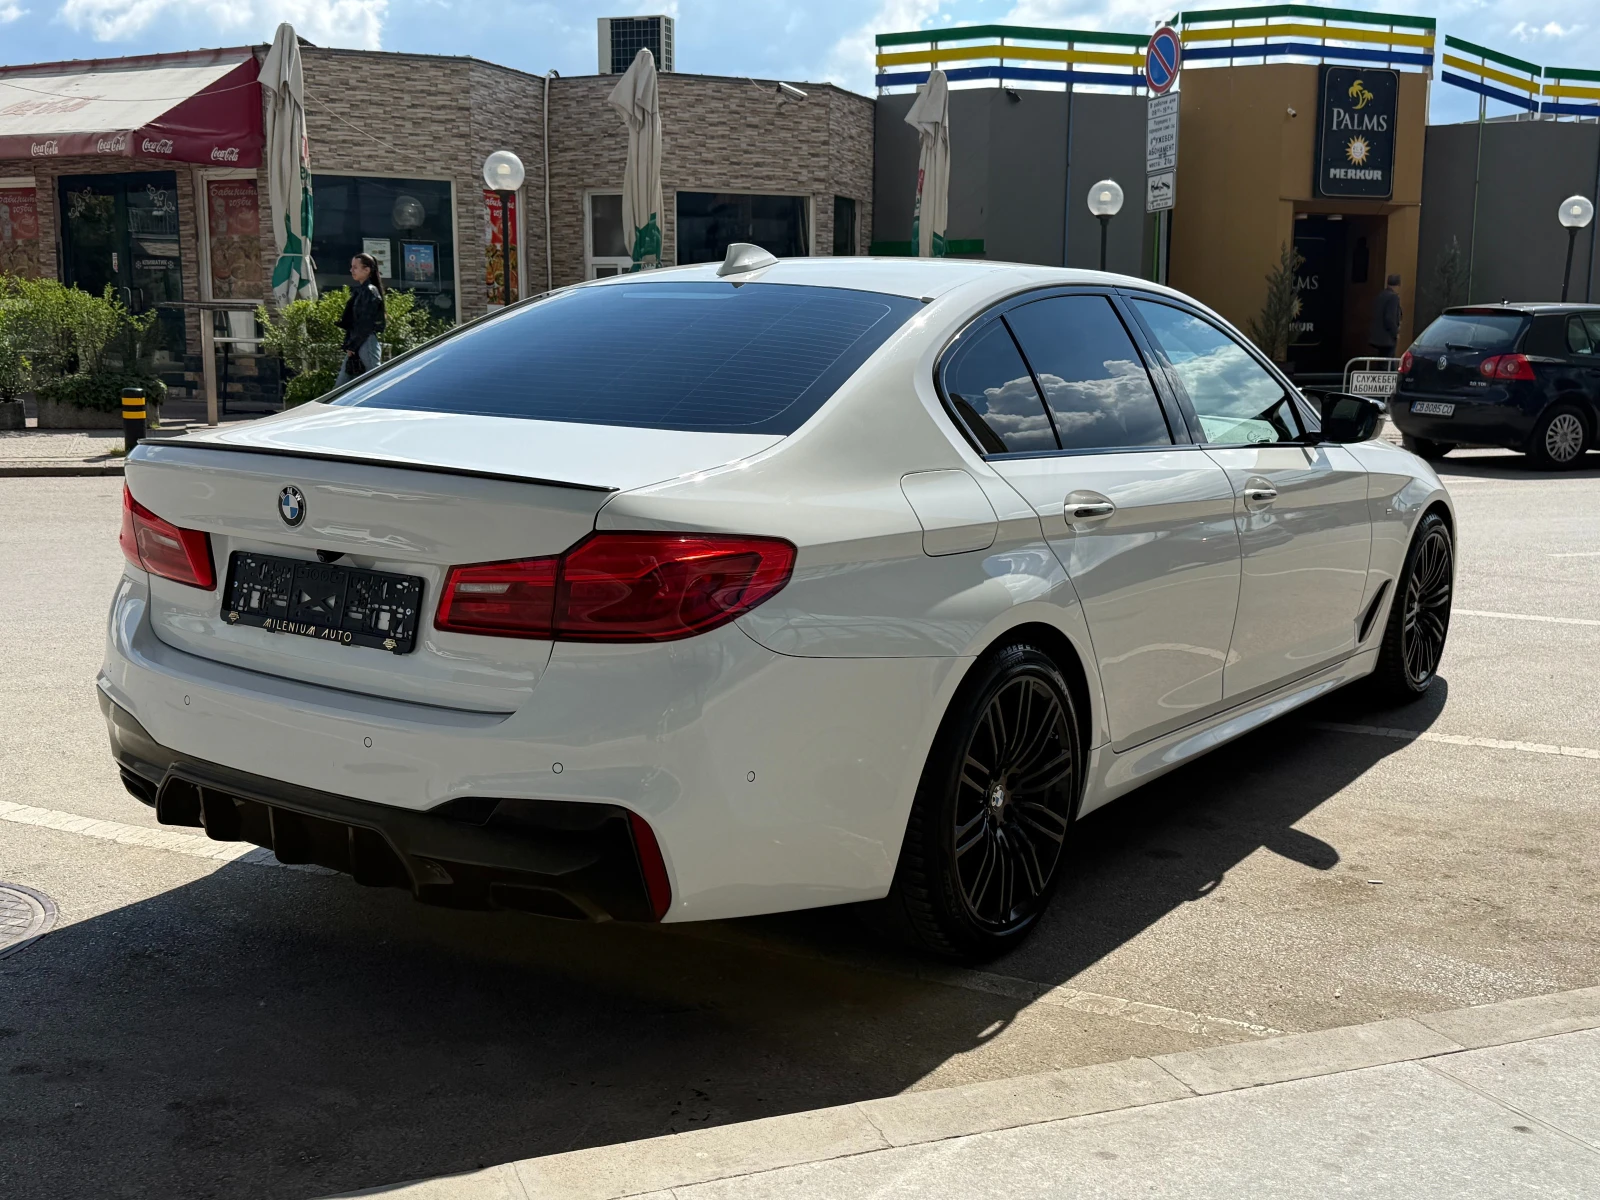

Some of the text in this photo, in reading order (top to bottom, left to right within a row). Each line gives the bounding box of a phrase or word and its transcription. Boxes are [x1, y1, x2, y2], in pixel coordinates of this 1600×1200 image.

[1331, 107, 1388, 132] PALMS
[1329, 168, 1382, 181] MERKUR
[1356, 374, 1398, 384] СЛУЖЕБЕН
[1353, 384, 1396, 393] АБОНАМЕН
[1424, 402, 1441, 413] 8085
[280, 486, 302, 501] BMW
[262, 617, 352, 642] MILENIUM AUTO
